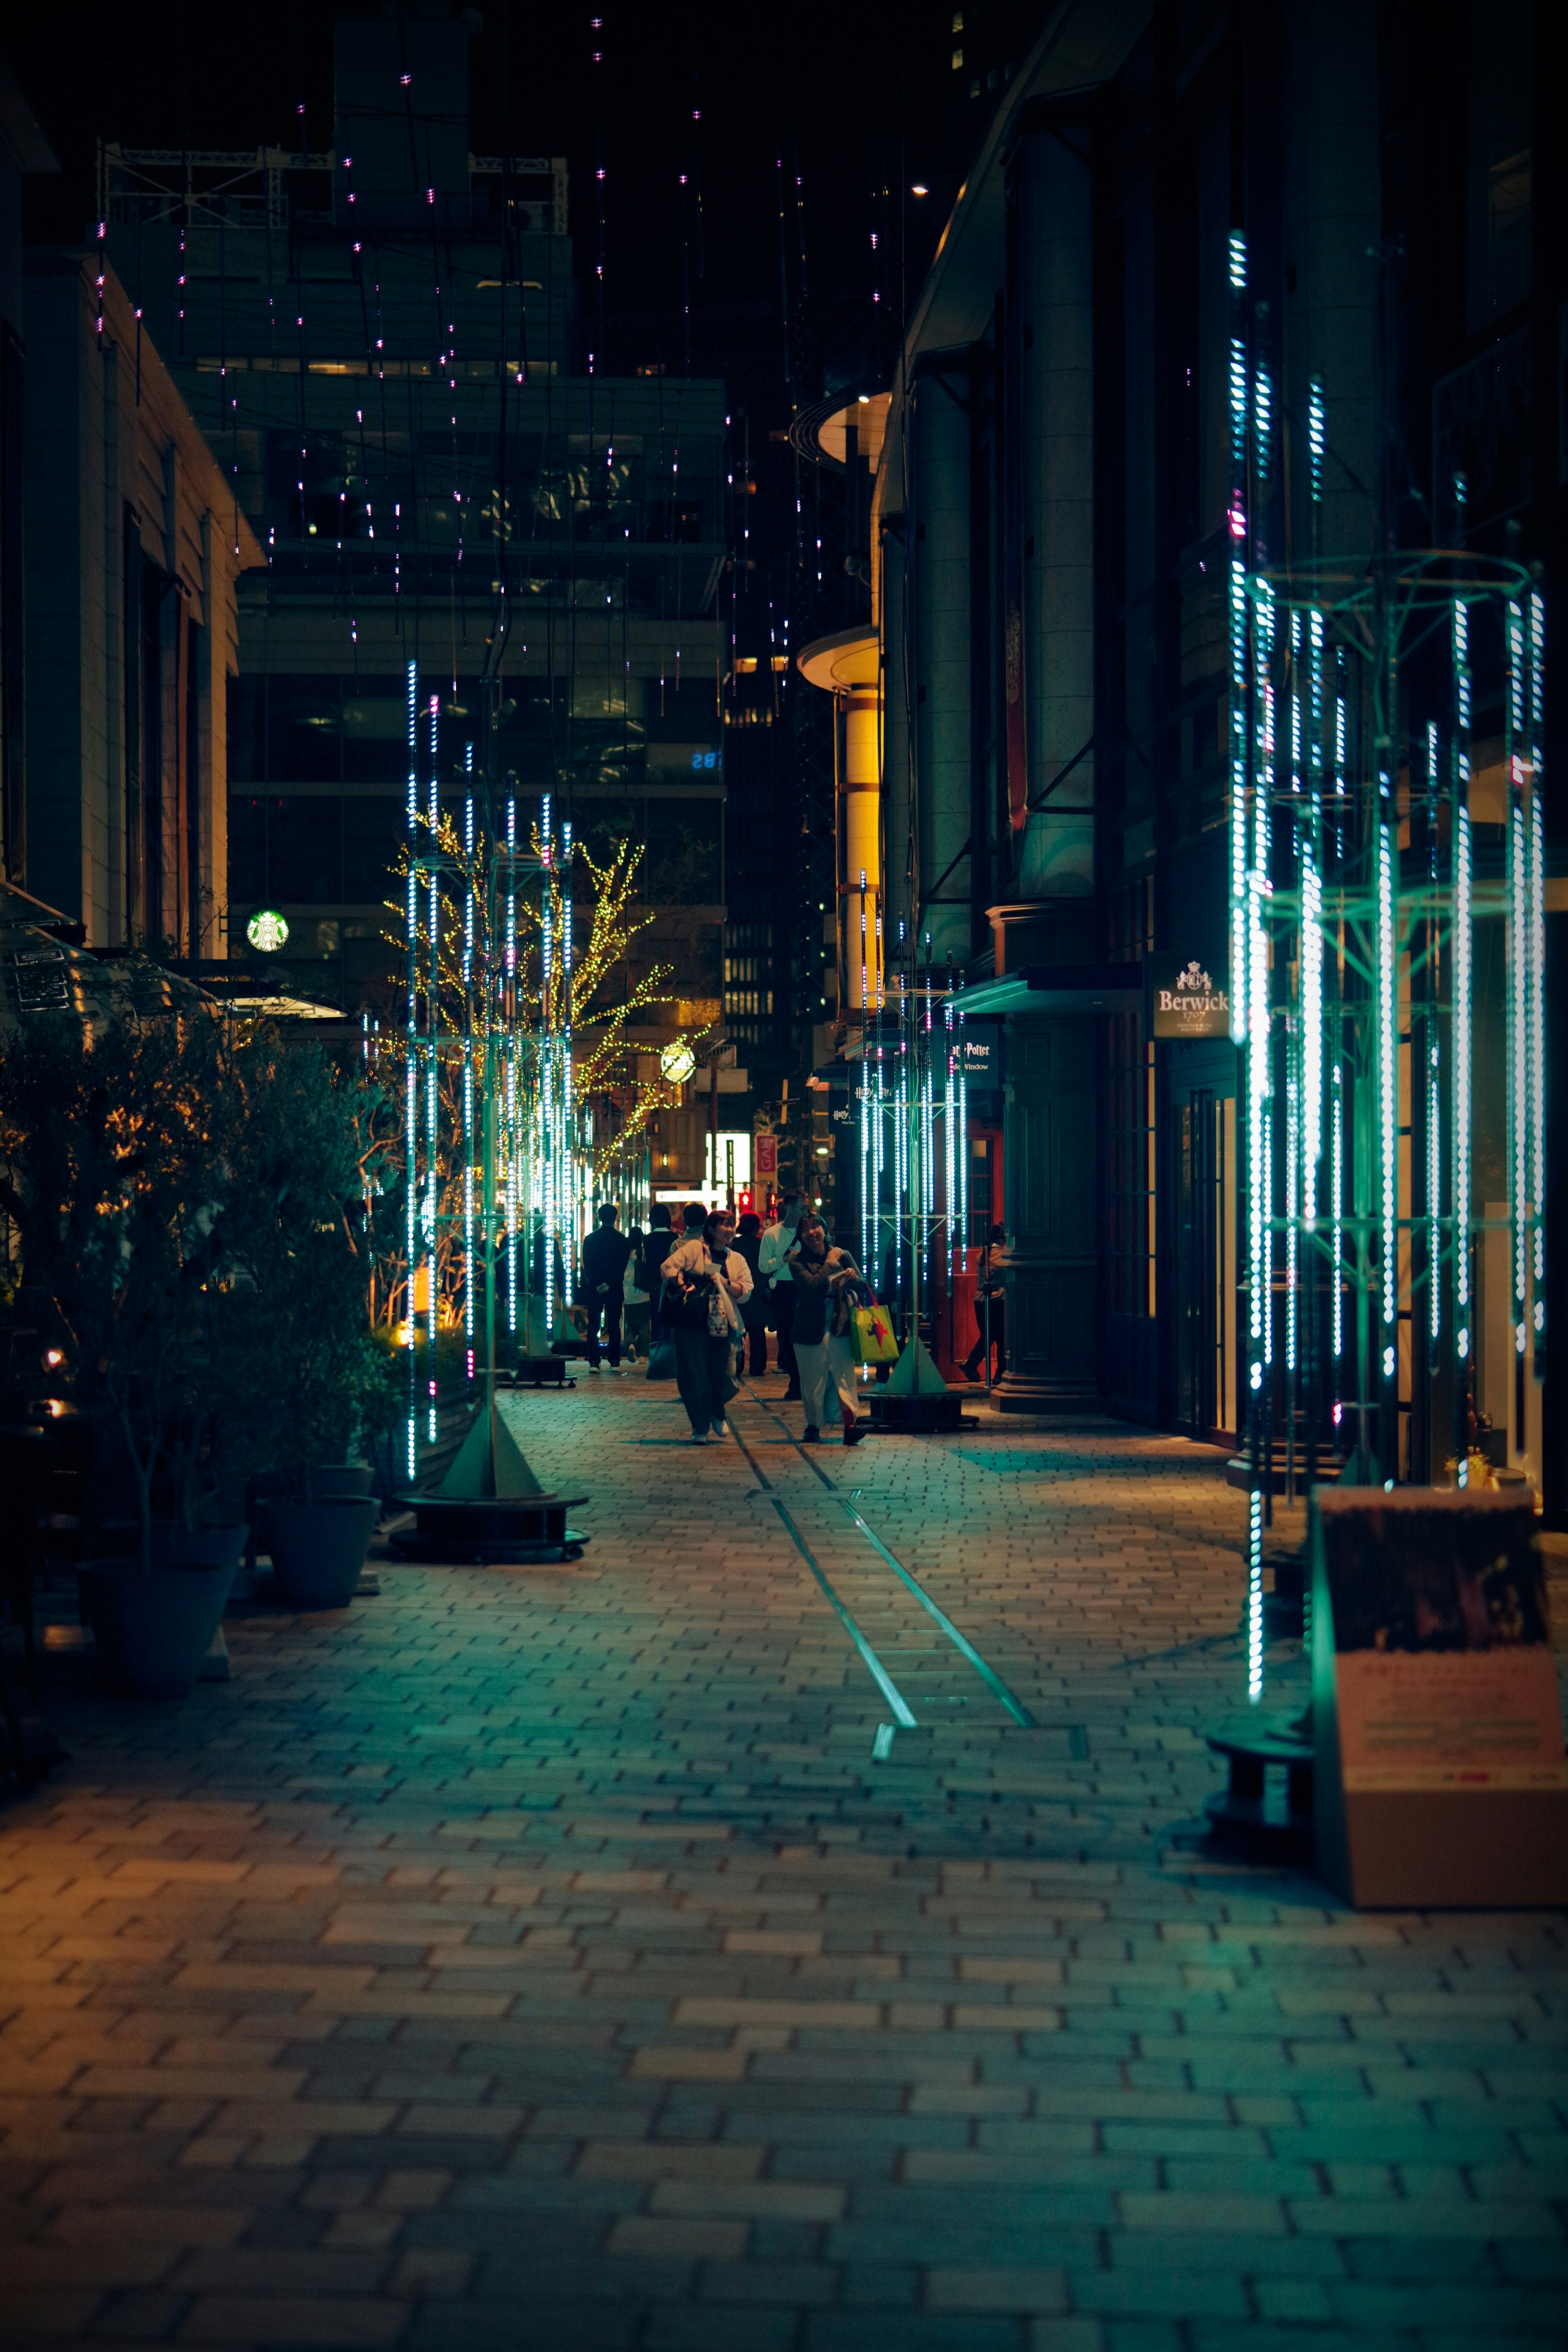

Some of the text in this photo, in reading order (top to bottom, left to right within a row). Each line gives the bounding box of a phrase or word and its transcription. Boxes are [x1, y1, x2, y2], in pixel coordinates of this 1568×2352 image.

[1158, 990, 1229, 1010] Berwick
[1183, 1011, 1205, 1022] 1707
[966, 1042, 990, 1060] Potter
[833, 1110, 849, 1120] Harry
